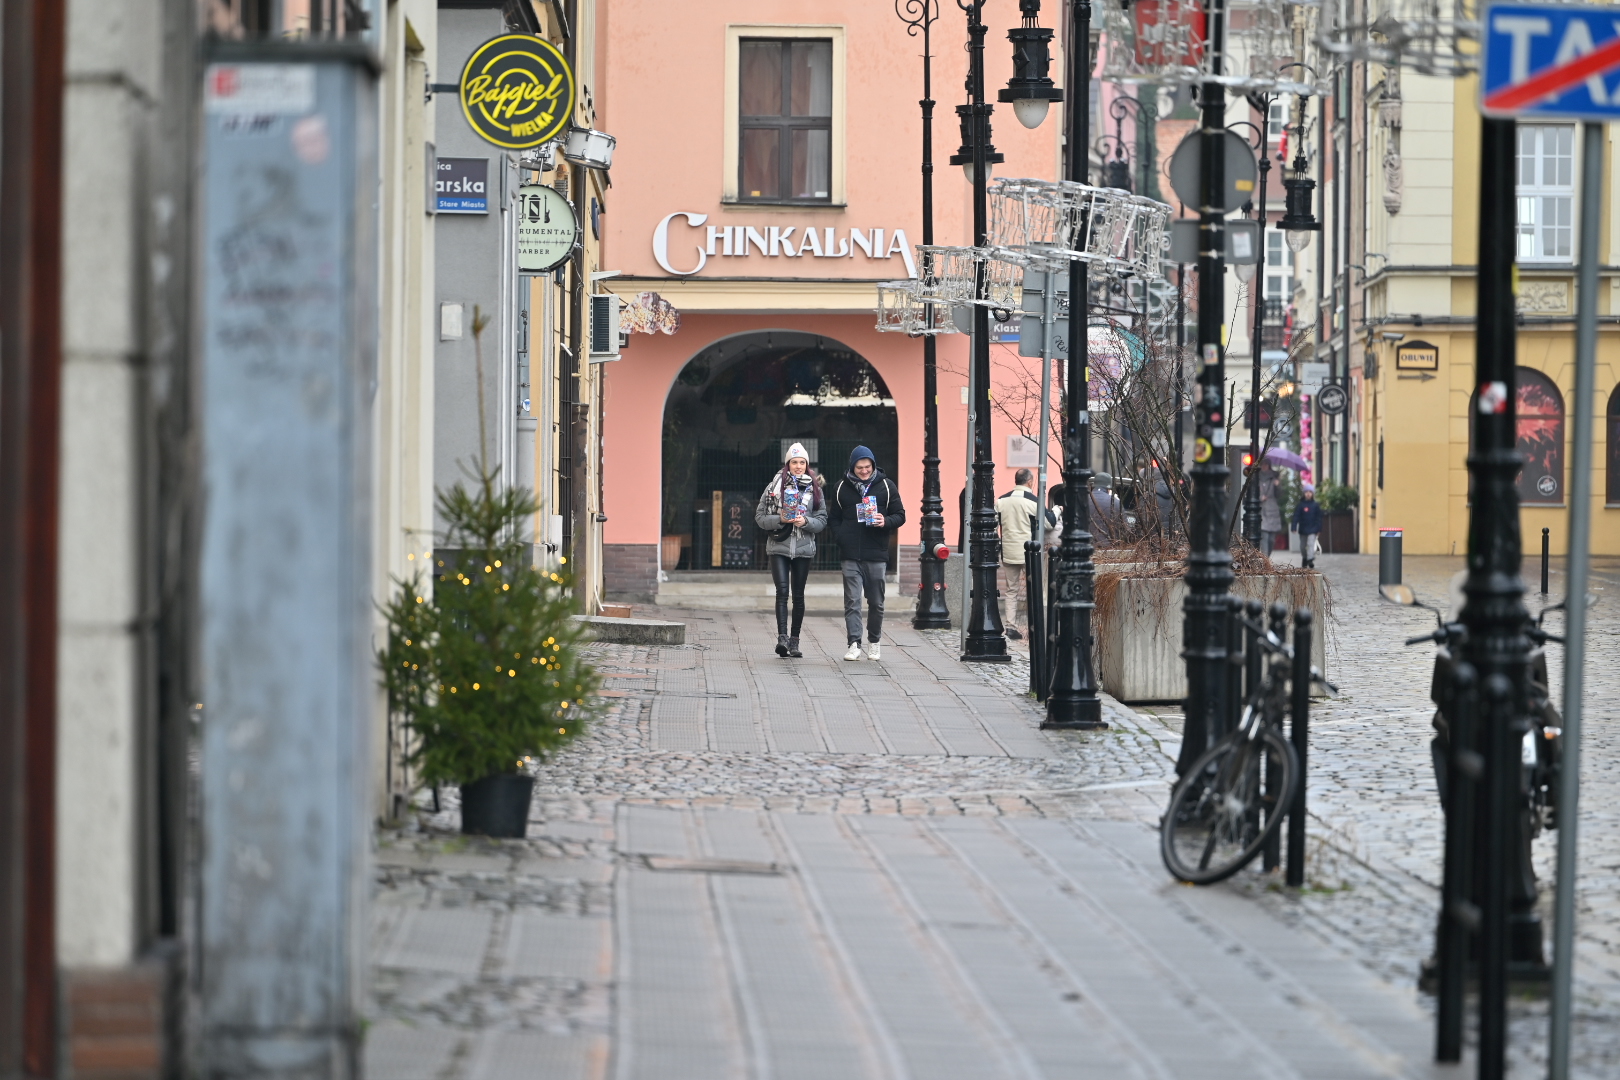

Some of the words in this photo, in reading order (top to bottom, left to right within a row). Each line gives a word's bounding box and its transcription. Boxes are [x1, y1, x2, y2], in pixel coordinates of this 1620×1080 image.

[1493, 15, 1620, 106] TA
[466, 73, 564, 119] Bajgiel
[511, 111, 555, 137] WIELKA
[1401, 353, 1434, 362] OBUWIE
